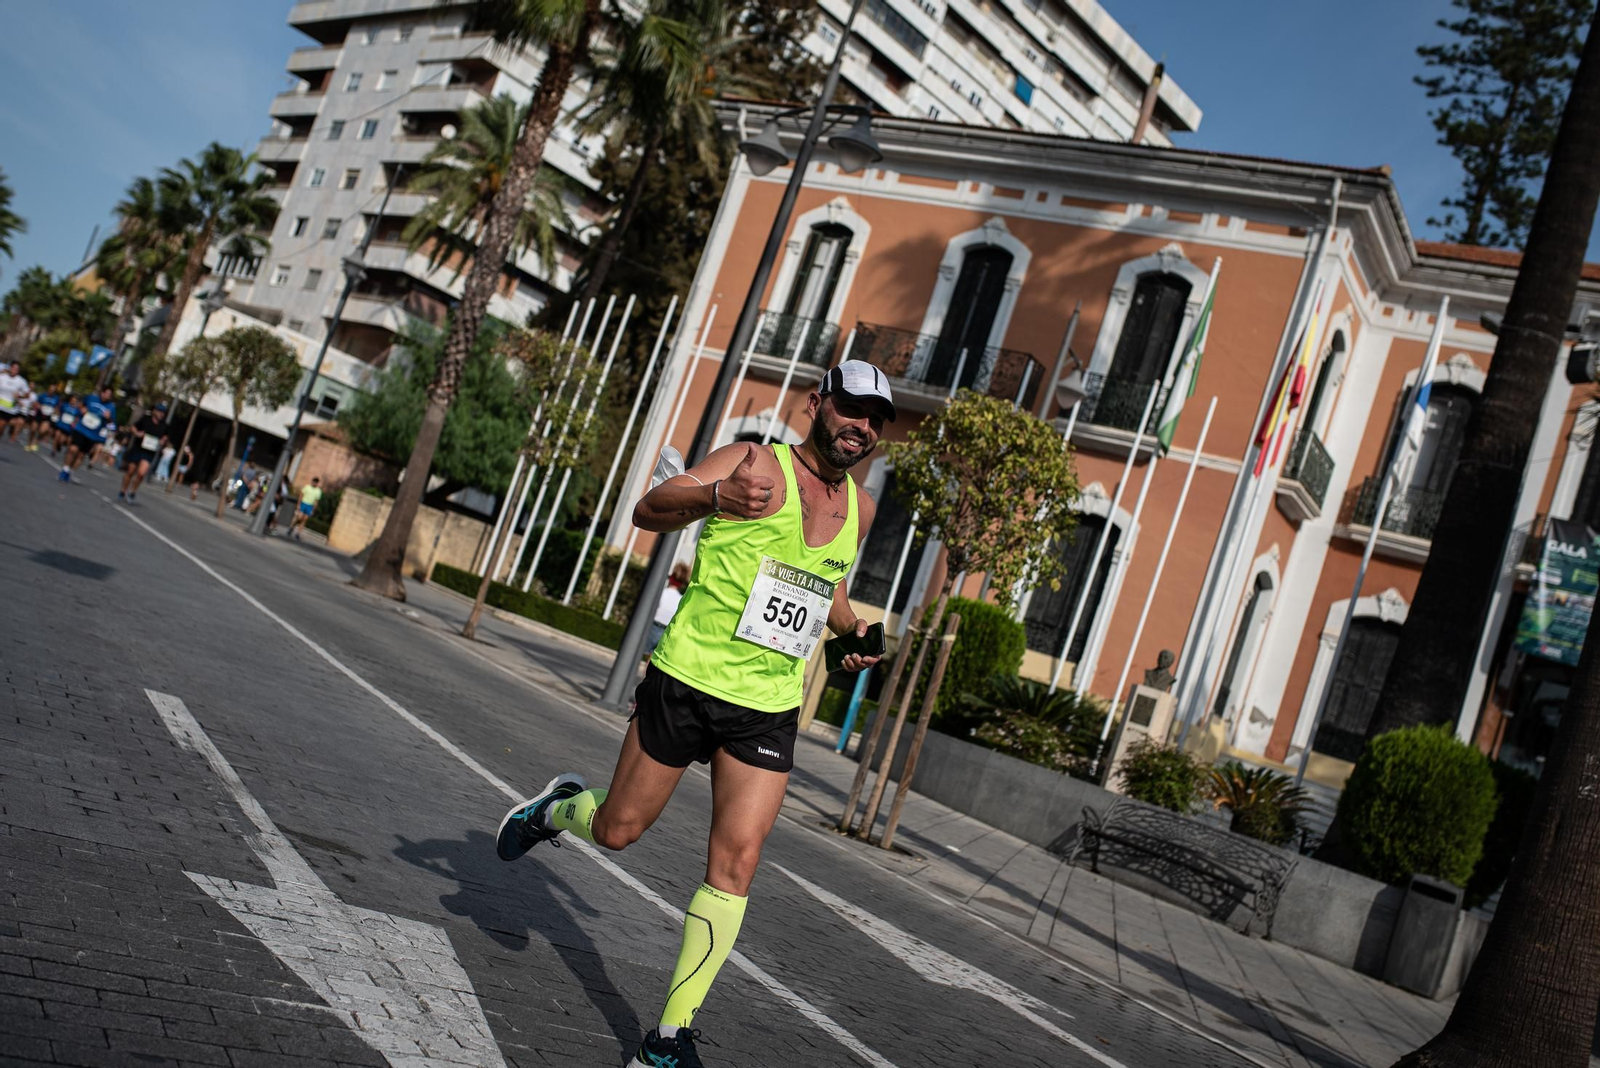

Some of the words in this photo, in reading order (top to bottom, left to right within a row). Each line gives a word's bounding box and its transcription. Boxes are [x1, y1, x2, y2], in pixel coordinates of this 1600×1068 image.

[773, 581, 808, 598] FERNANDO
[778, 566, 806, 587] VUELTA
[807, 578, 812, 590] A
[763, 596, 807, 632] 550
